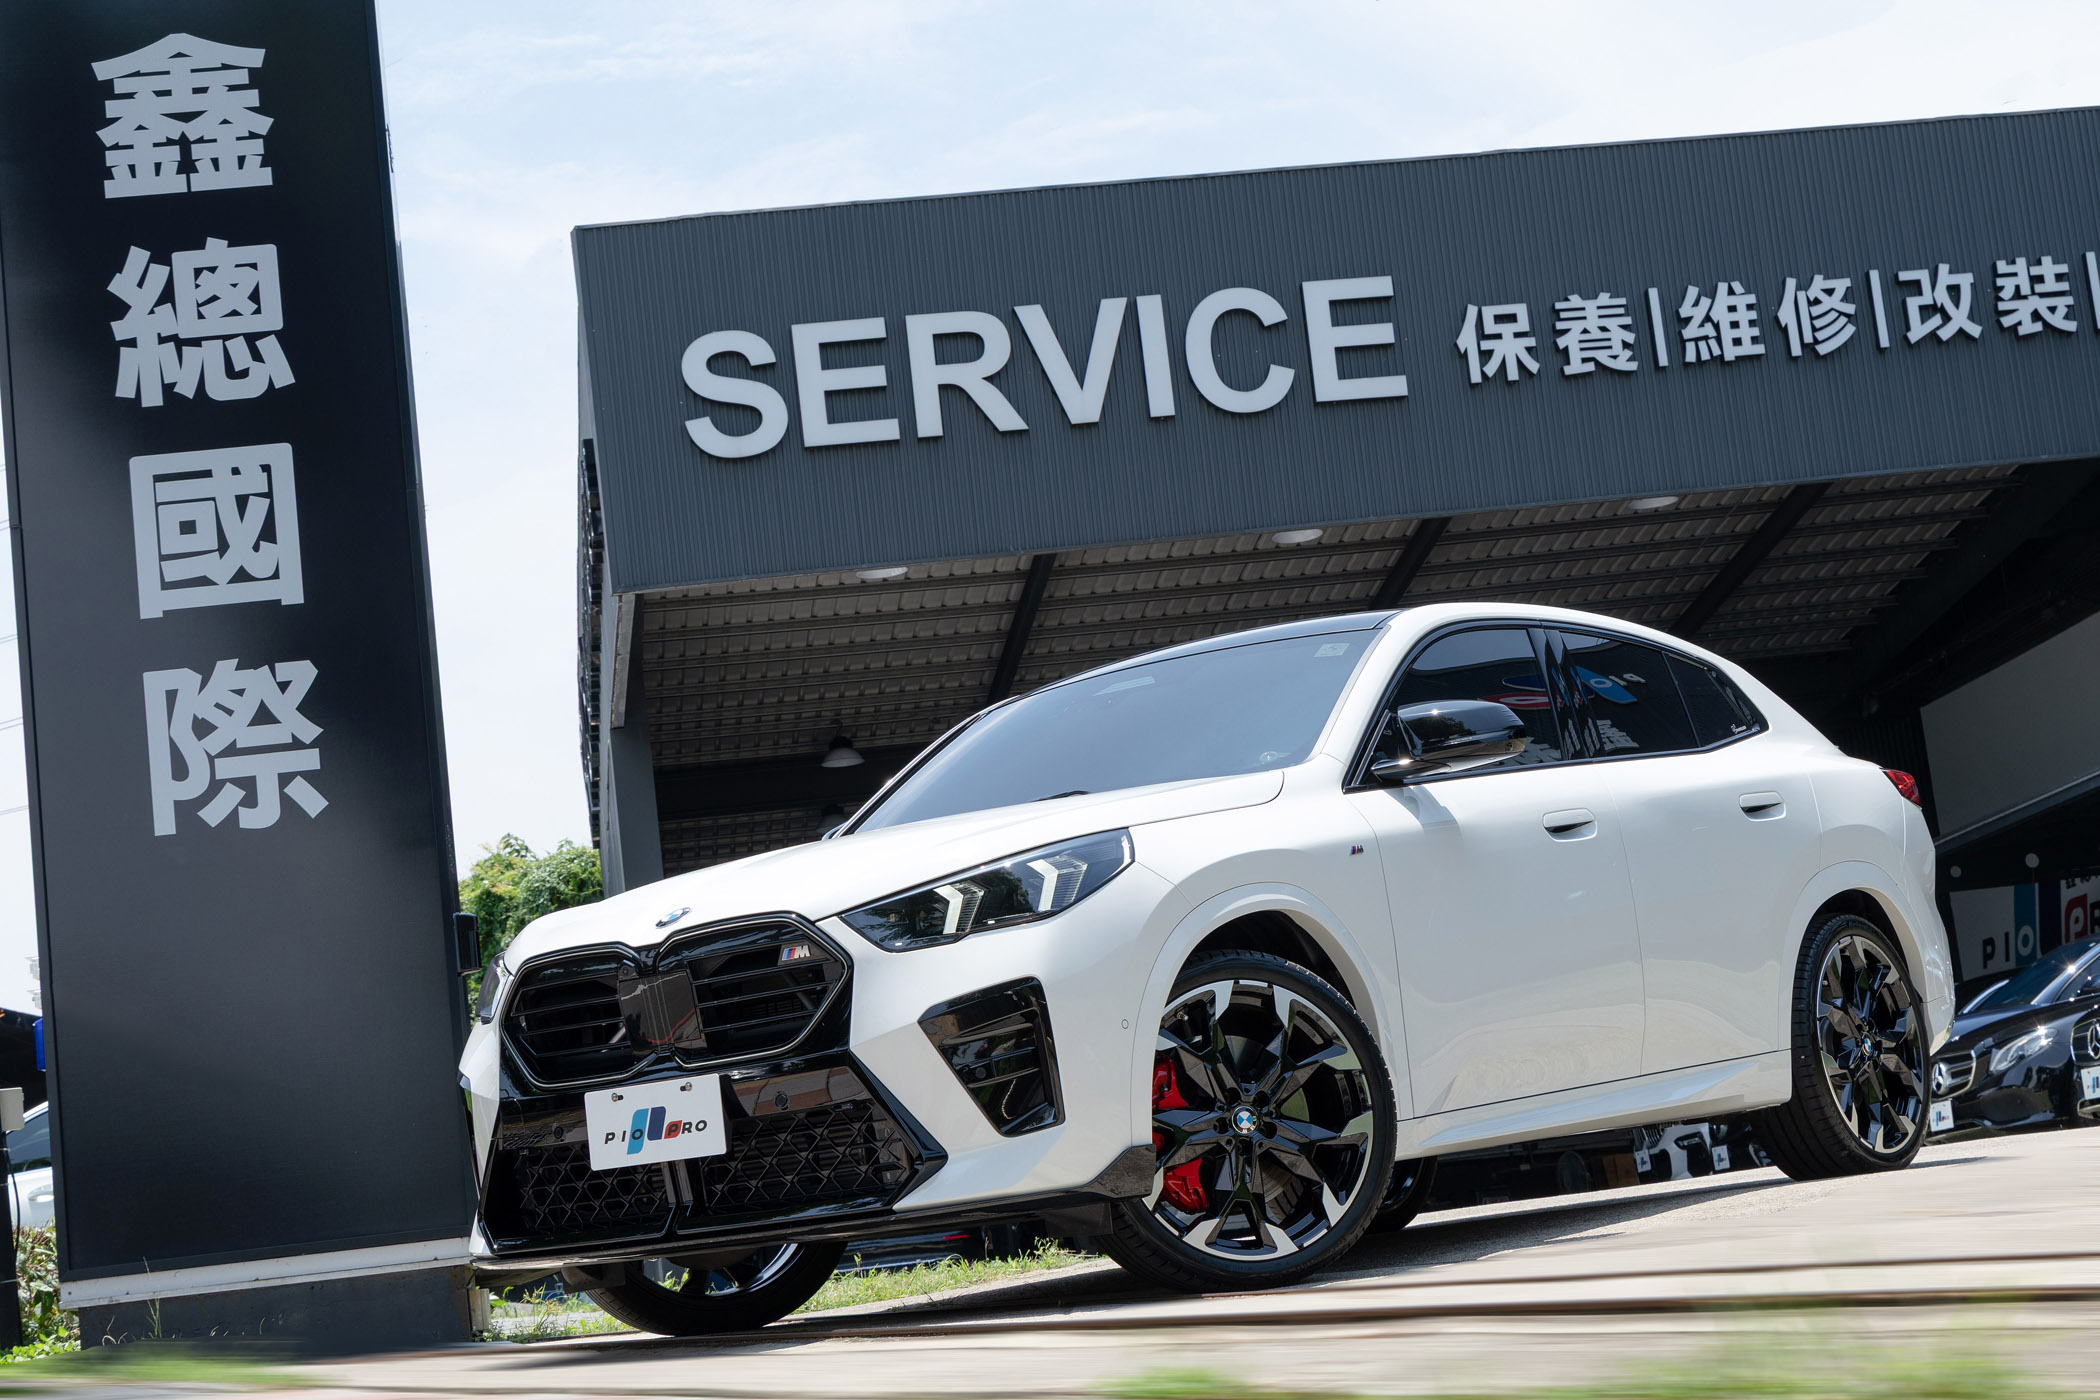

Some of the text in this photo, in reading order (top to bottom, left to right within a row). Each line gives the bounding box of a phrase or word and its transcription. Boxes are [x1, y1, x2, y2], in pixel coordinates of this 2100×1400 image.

[91, 33, 329, 836] 鑫總國際
[681, 275, 1408, 459] SERVICE
